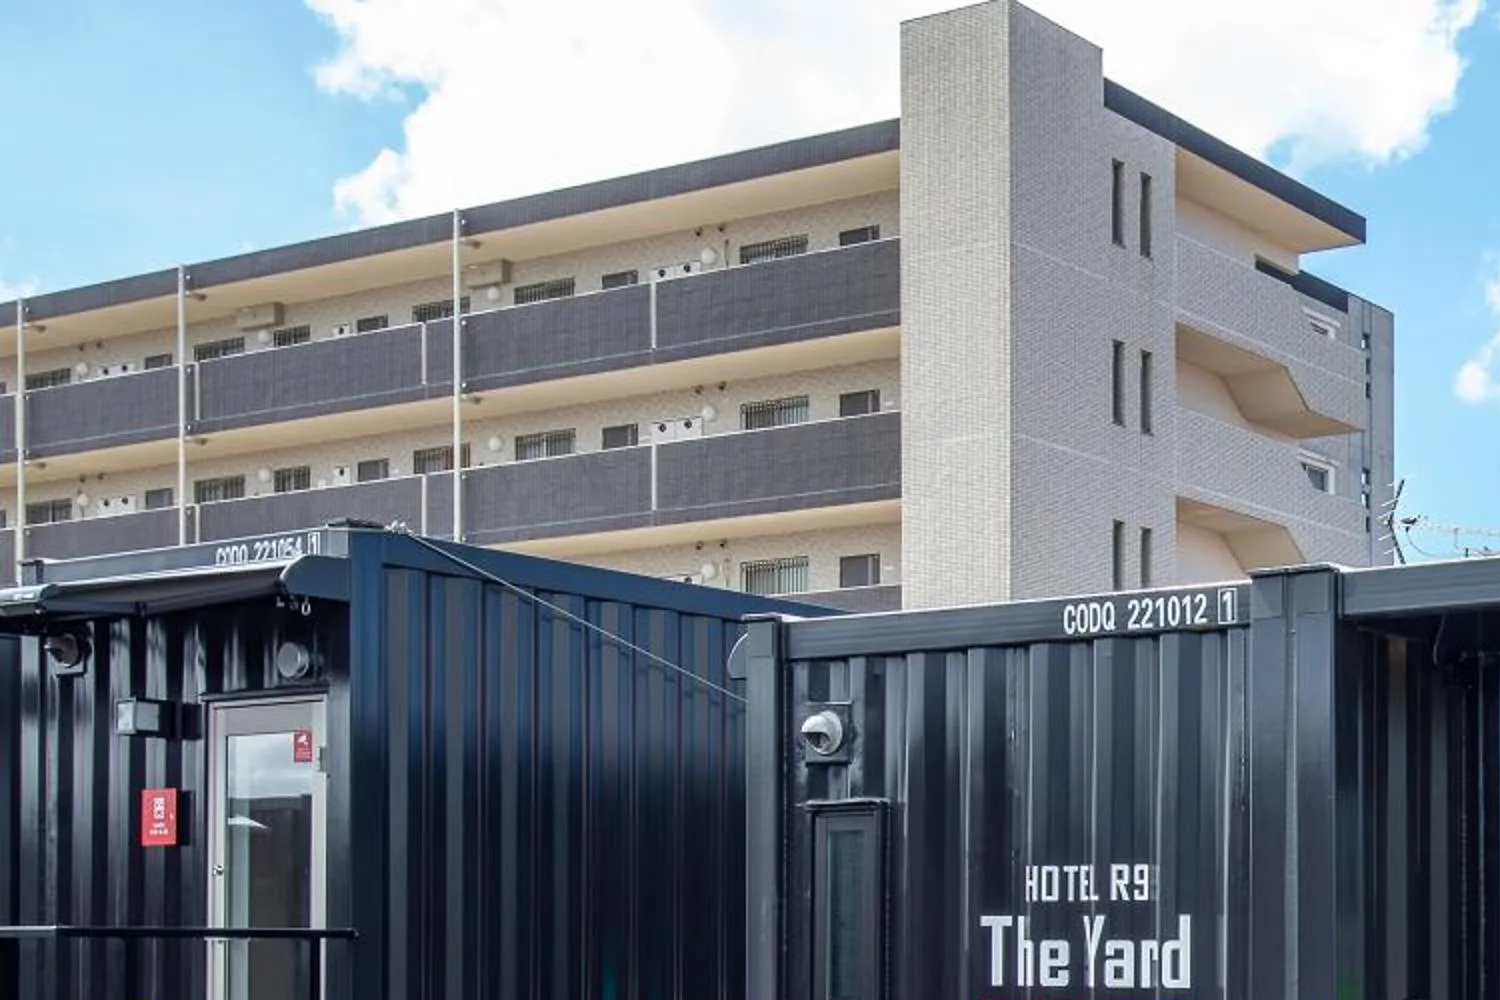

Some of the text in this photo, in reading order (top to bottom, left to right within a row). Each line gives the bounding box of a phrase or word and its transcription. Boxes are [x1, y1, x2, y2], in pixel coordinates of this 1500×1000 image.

[1063, 589, 1235, 635] CODQ 221012 1
[1025, 863, 1149, 902] HOTEL R9
[980, 914, 1191, 989] The Yard
